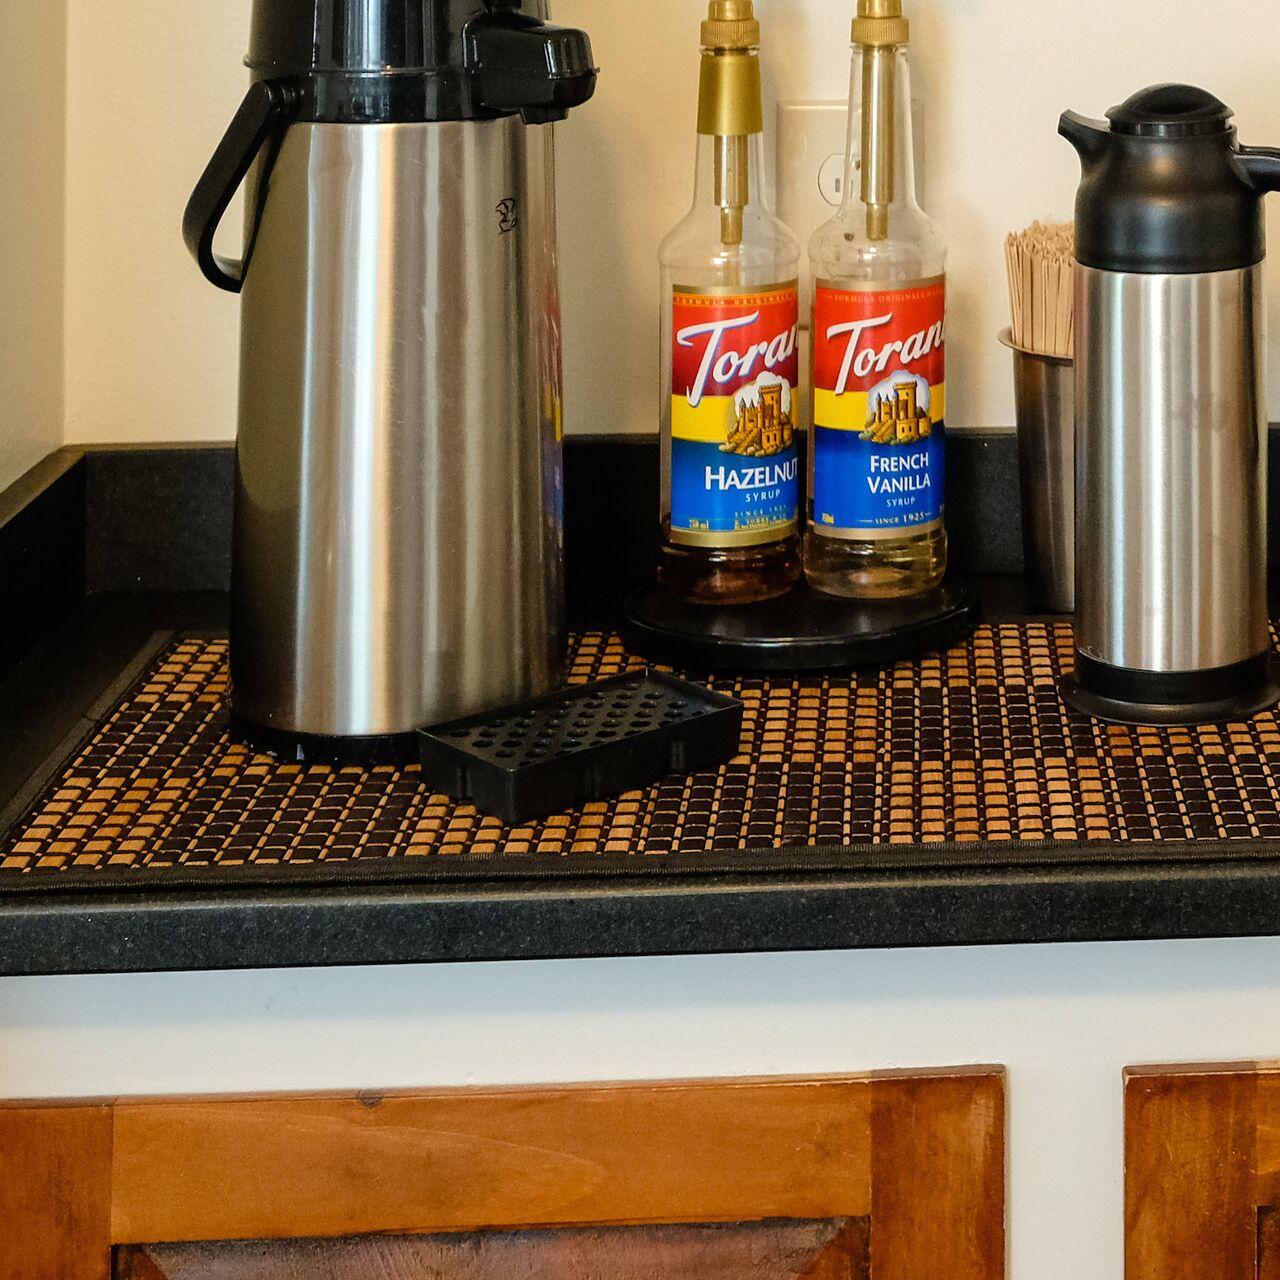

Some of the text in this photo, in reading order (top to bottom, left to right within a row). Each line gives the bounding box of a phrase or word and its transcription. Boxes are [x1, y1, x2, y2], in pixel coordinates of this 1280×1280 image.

[870, 451, 929, 474] FRENCH
[704, 457, 798, 491] HAZELNUT
[866, 473, 931, 495] VANILLA
[745, 488, 781, 502] SYRUP
[886, 496, 915, 508] SYRUP
[875, 516, 900, 525] SINCE
